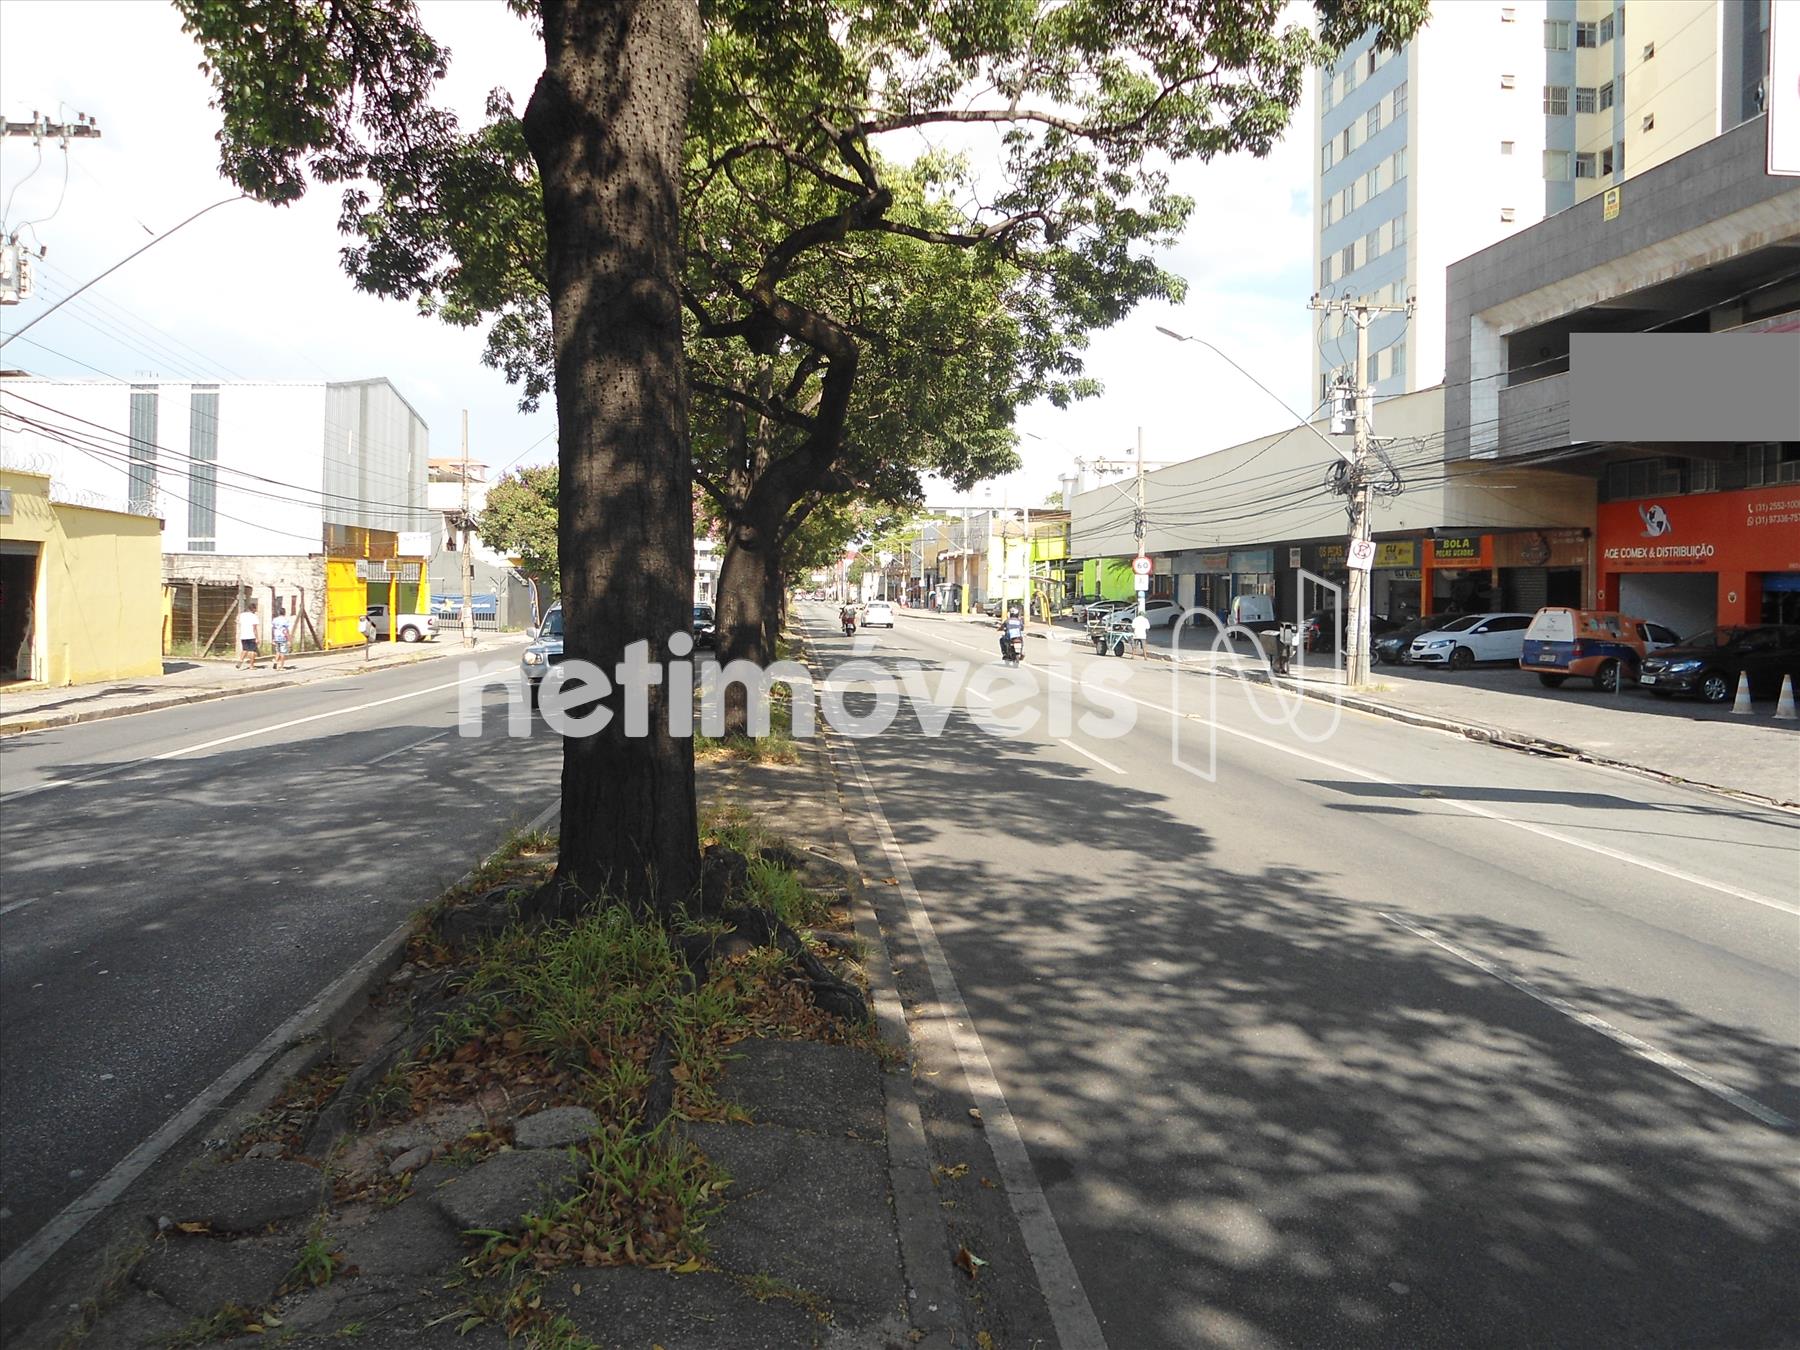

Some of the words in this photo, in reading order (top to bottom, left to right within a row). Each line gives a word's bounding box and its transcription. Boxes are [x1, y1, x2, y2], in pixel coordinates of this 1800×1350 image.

[1443, 538, 1470, 548] BOLA
[1621, 547, 1648, 558] COMEX
[1649, 547, 1655, 558] &
[1656, 543, 1714, 559] DISTRIBUIÇÃO
